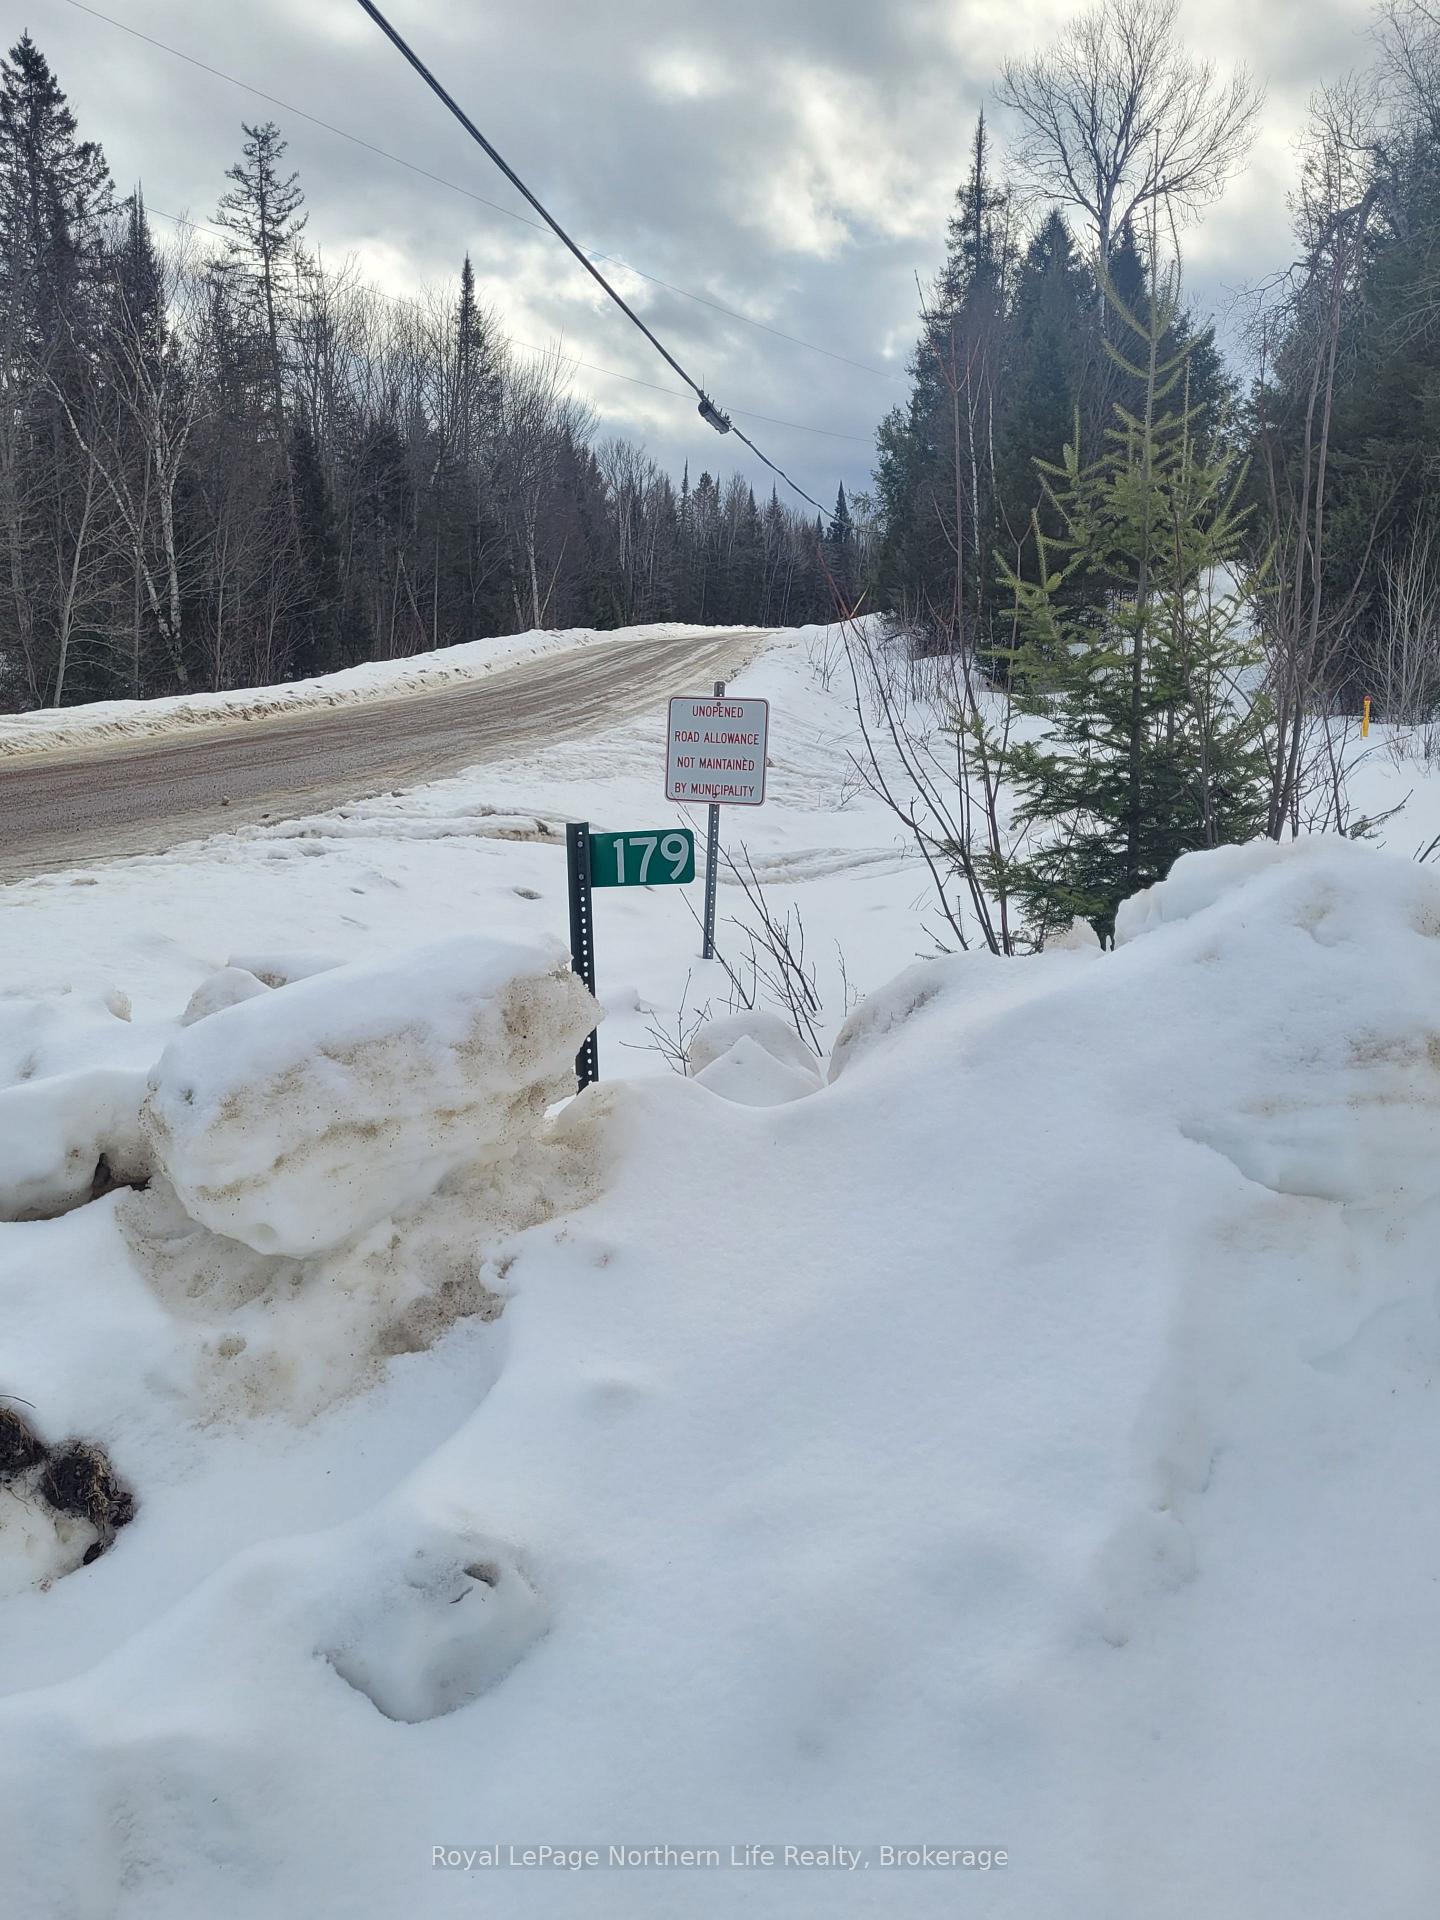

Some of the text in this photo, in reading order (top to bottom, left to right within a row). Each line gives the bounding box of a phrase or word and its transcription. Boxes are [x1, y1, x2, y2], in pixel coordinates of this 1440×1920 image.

[692, 705, 744, 718] UNOPENED
[674, 731, 760, 745] ROAD ALLOWANCE
[677, 757, 755, 771] NOT MAINTAINED
[674, 782, 755, 797] BY MUNICIPALITY
[613, 833, 690, 883] 179
